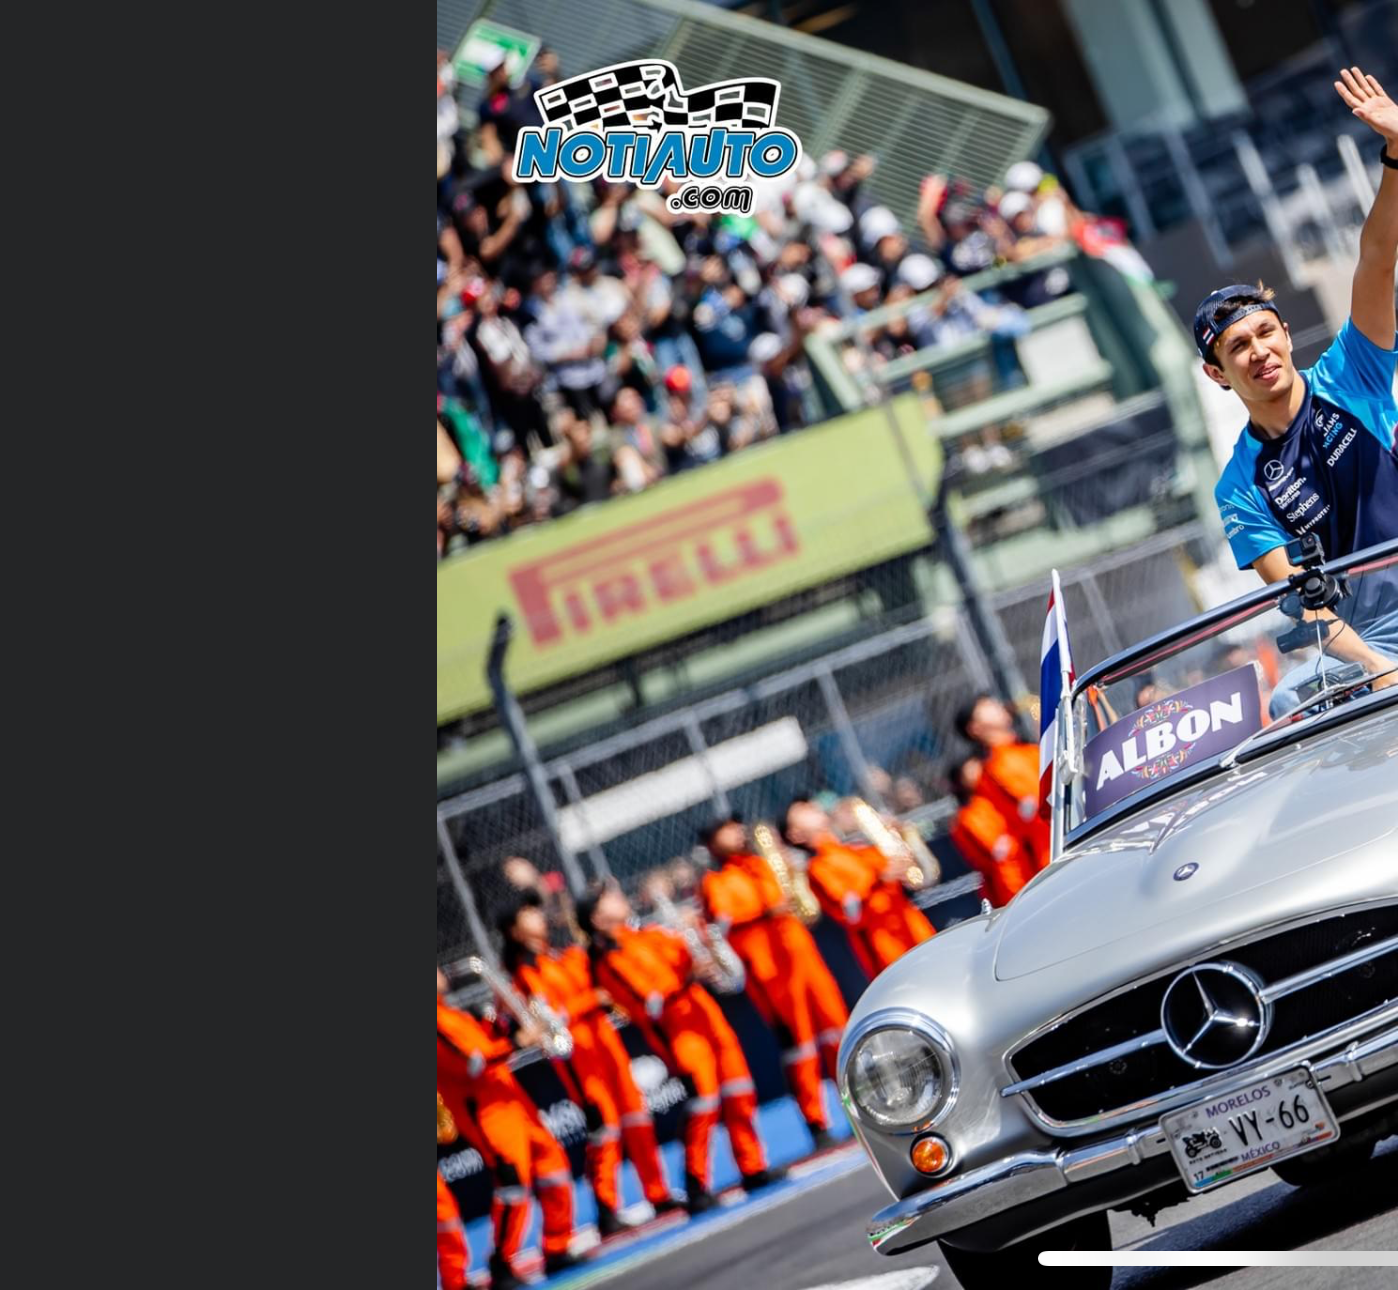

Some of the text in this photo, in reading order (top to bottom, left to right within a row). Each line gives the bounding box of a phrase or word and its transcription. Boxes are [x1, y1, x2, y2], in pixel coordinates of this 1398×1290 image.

[1326, 427, 1358, 467] DURACELL
[1286, 492, 1320, 523] Stephens
[508, 474, 801, 650] PIRELLI
[1096, 691, 1243, 792] ALBON
[1206, 1085, 1271, 1119] MORELOS
[1228, 1094, 1310, 1147] VY-66
[1240, 1141, 1280, 1162] MÉXICO
